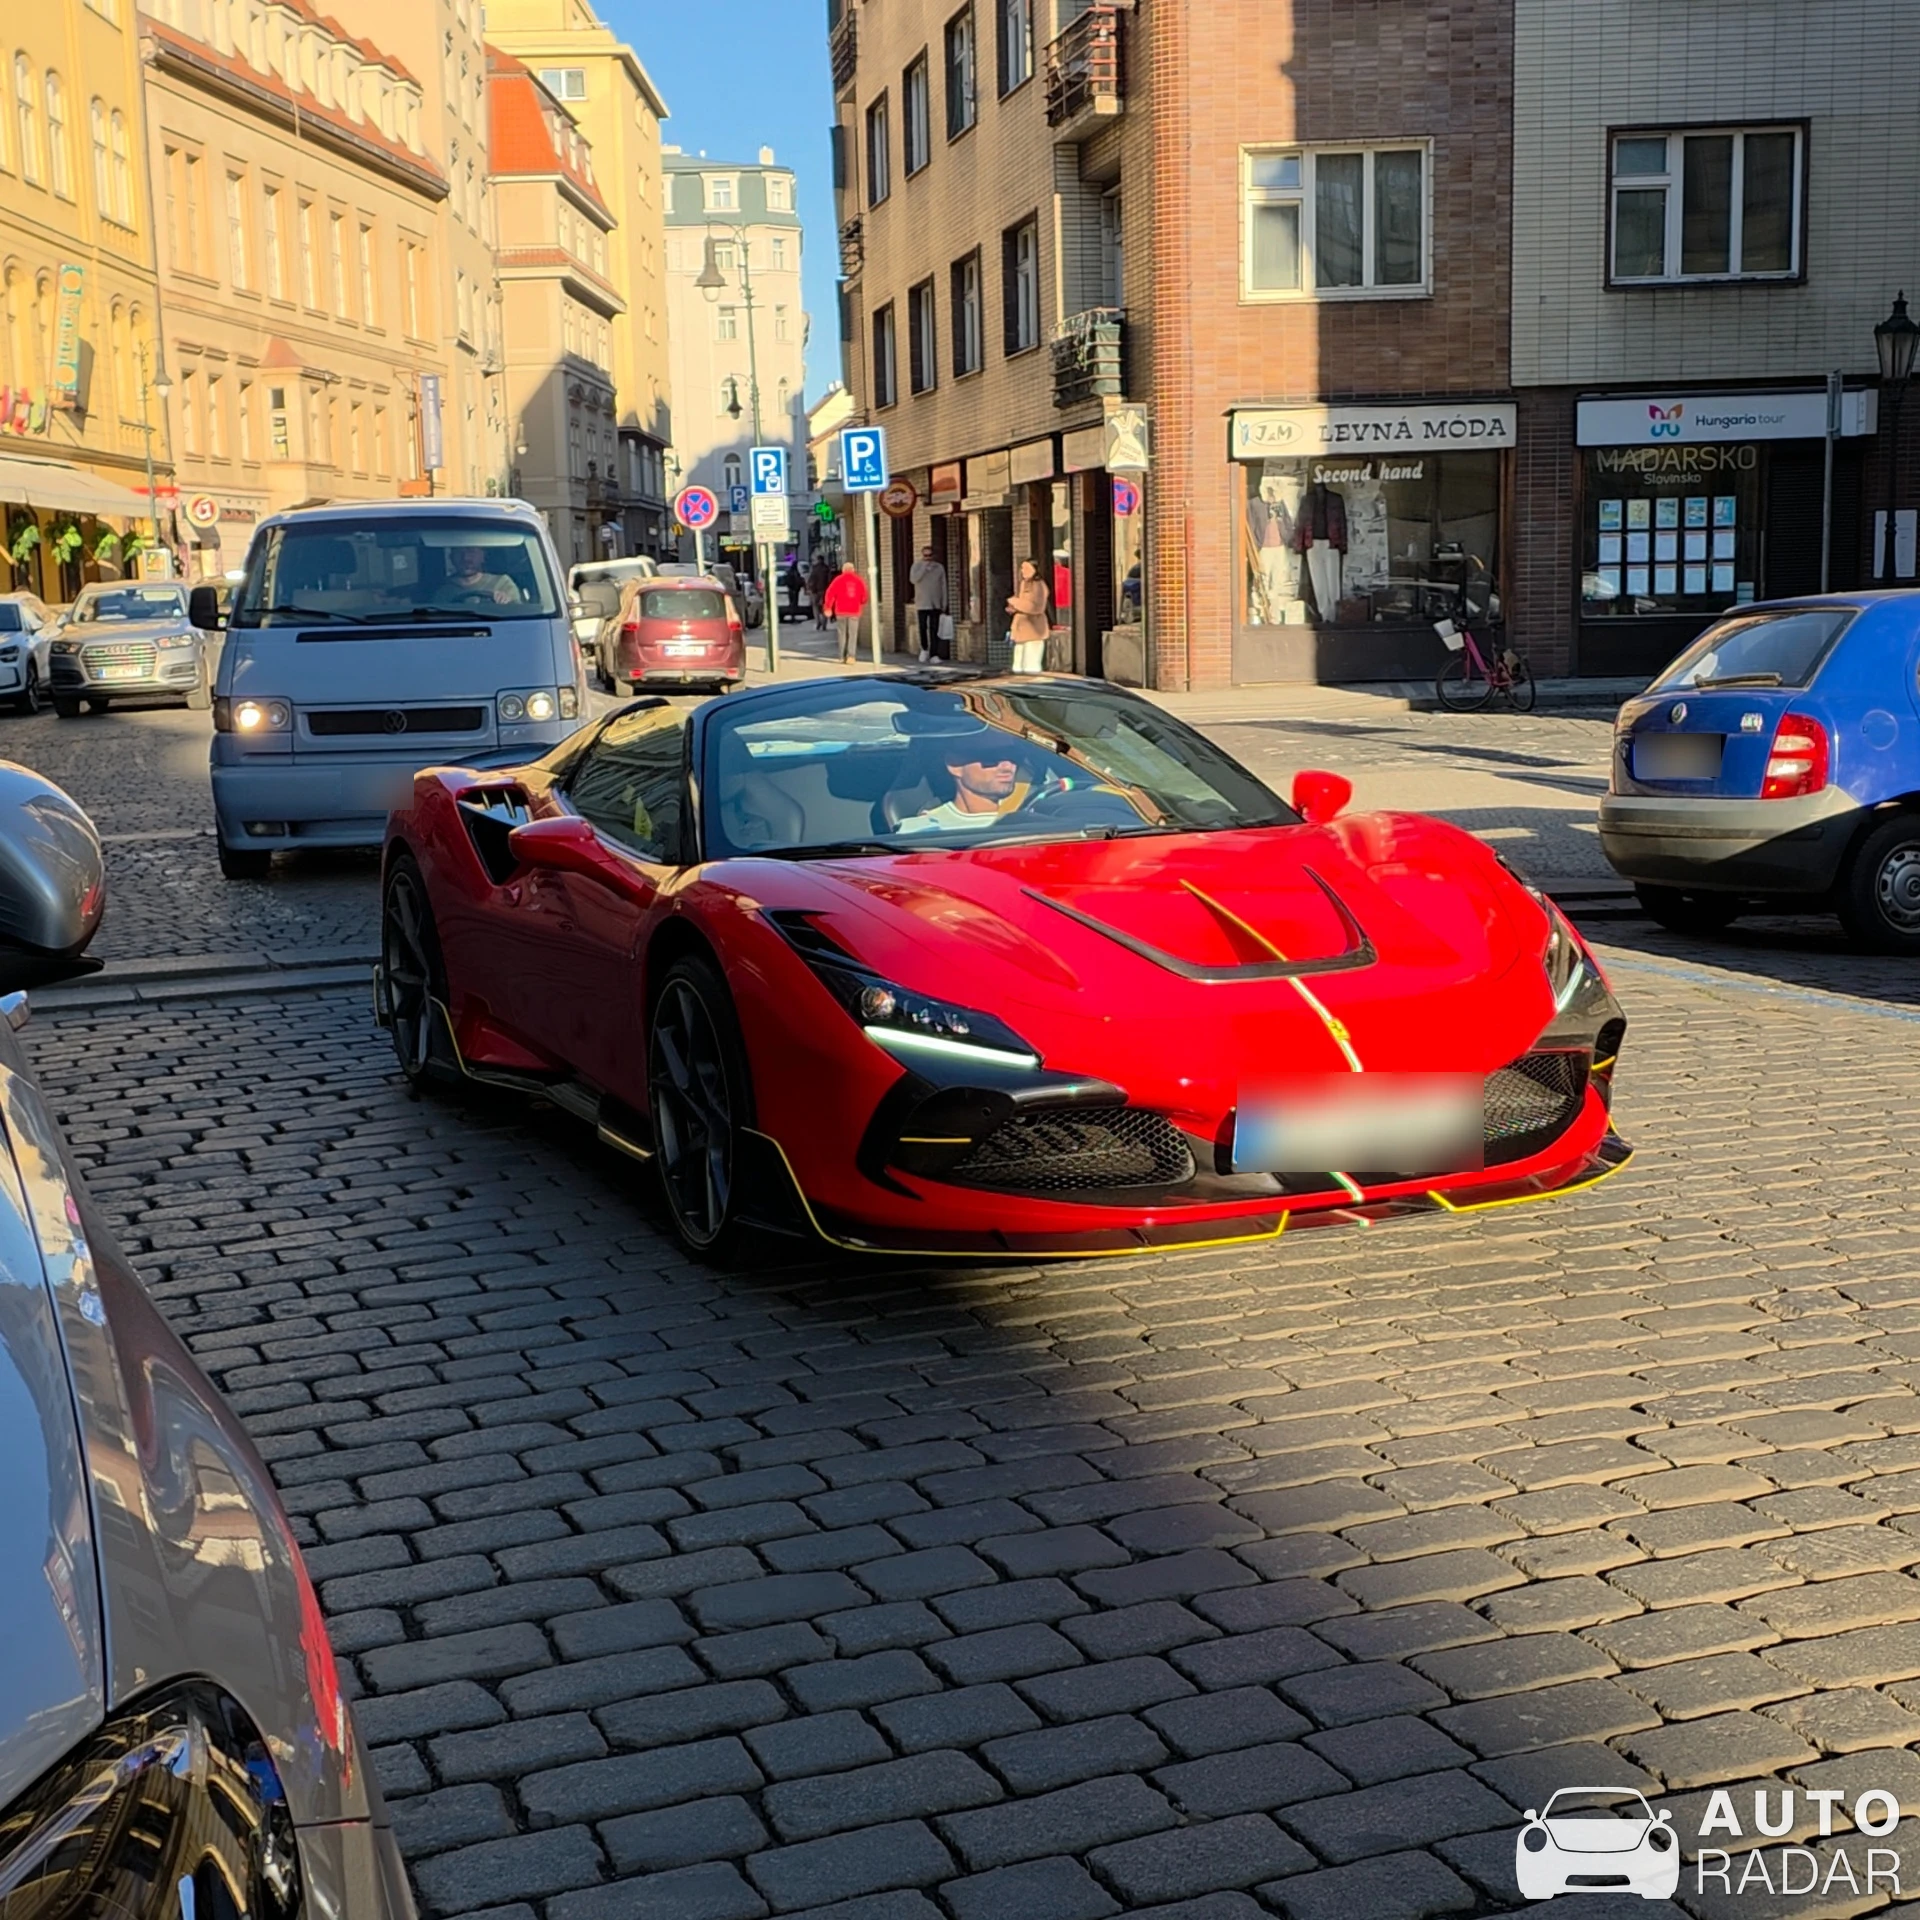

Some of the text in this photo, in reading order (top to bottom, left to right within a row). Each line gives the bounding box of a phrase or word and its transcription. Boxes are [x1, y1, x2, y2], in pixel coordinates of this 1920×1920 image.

[1318, 414, 1506, 442] LEVNÁ MÓDA
[1758, 414, 1786, 425] tour
[1312, 461, 1424, 484] Second hand
[1643, 472, 1702, 485] Slovinsko
